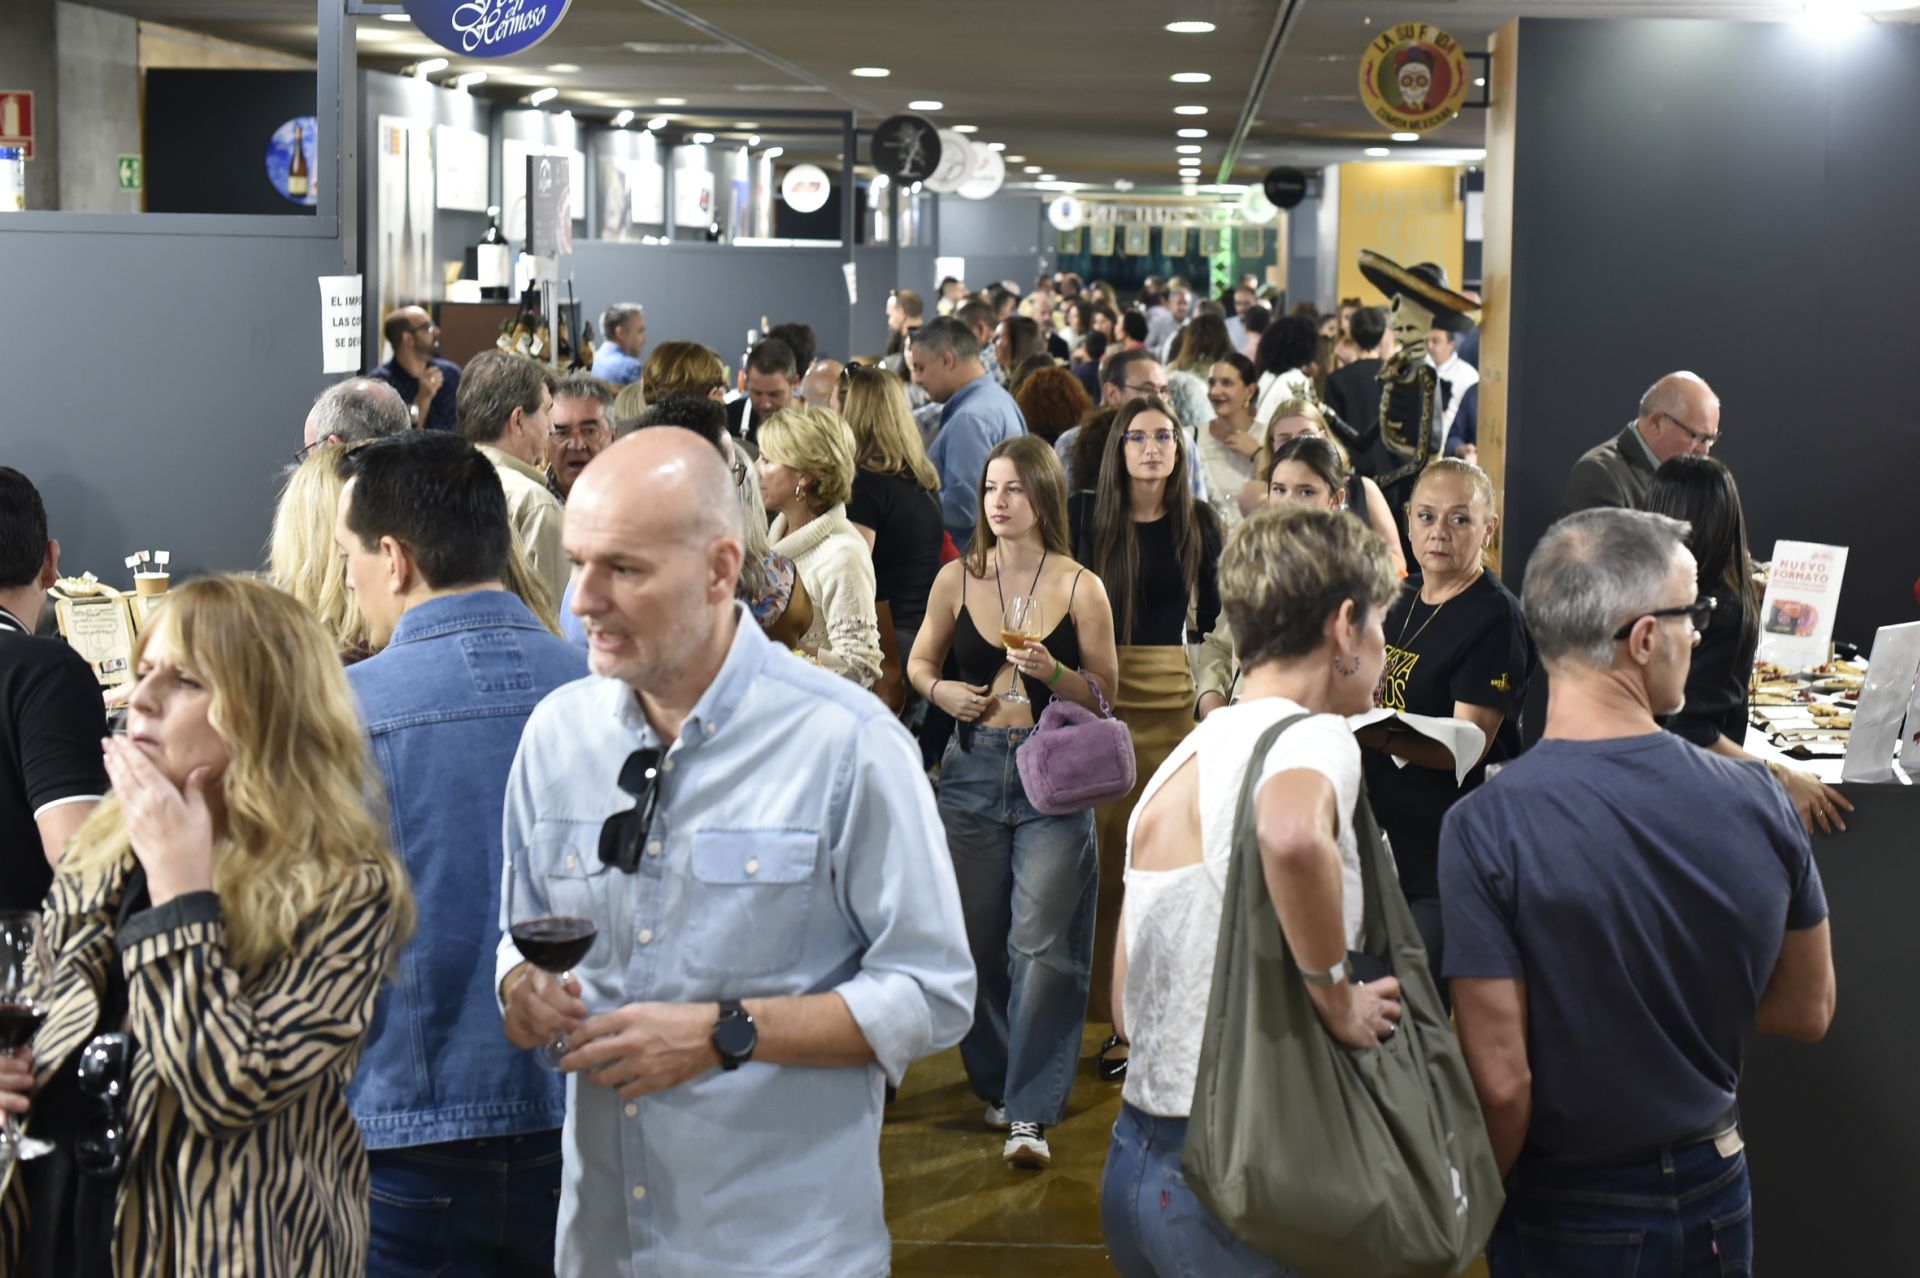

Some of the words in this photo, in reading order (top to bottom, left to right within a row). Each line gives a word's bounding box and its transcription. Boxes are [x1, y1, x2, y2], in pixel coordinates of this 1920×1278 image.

[462, 5, 547, 52] Hermoso
[1373, 33, 1395, 53] LA
[331, 296, 343, 307] EL
[332, 317, 350, 327] LAS
[335, 337, 346, 348] SE
[1780, 559, 1826, 572] NUEVO
[1773, 569, 1829, 583] FORMATO
